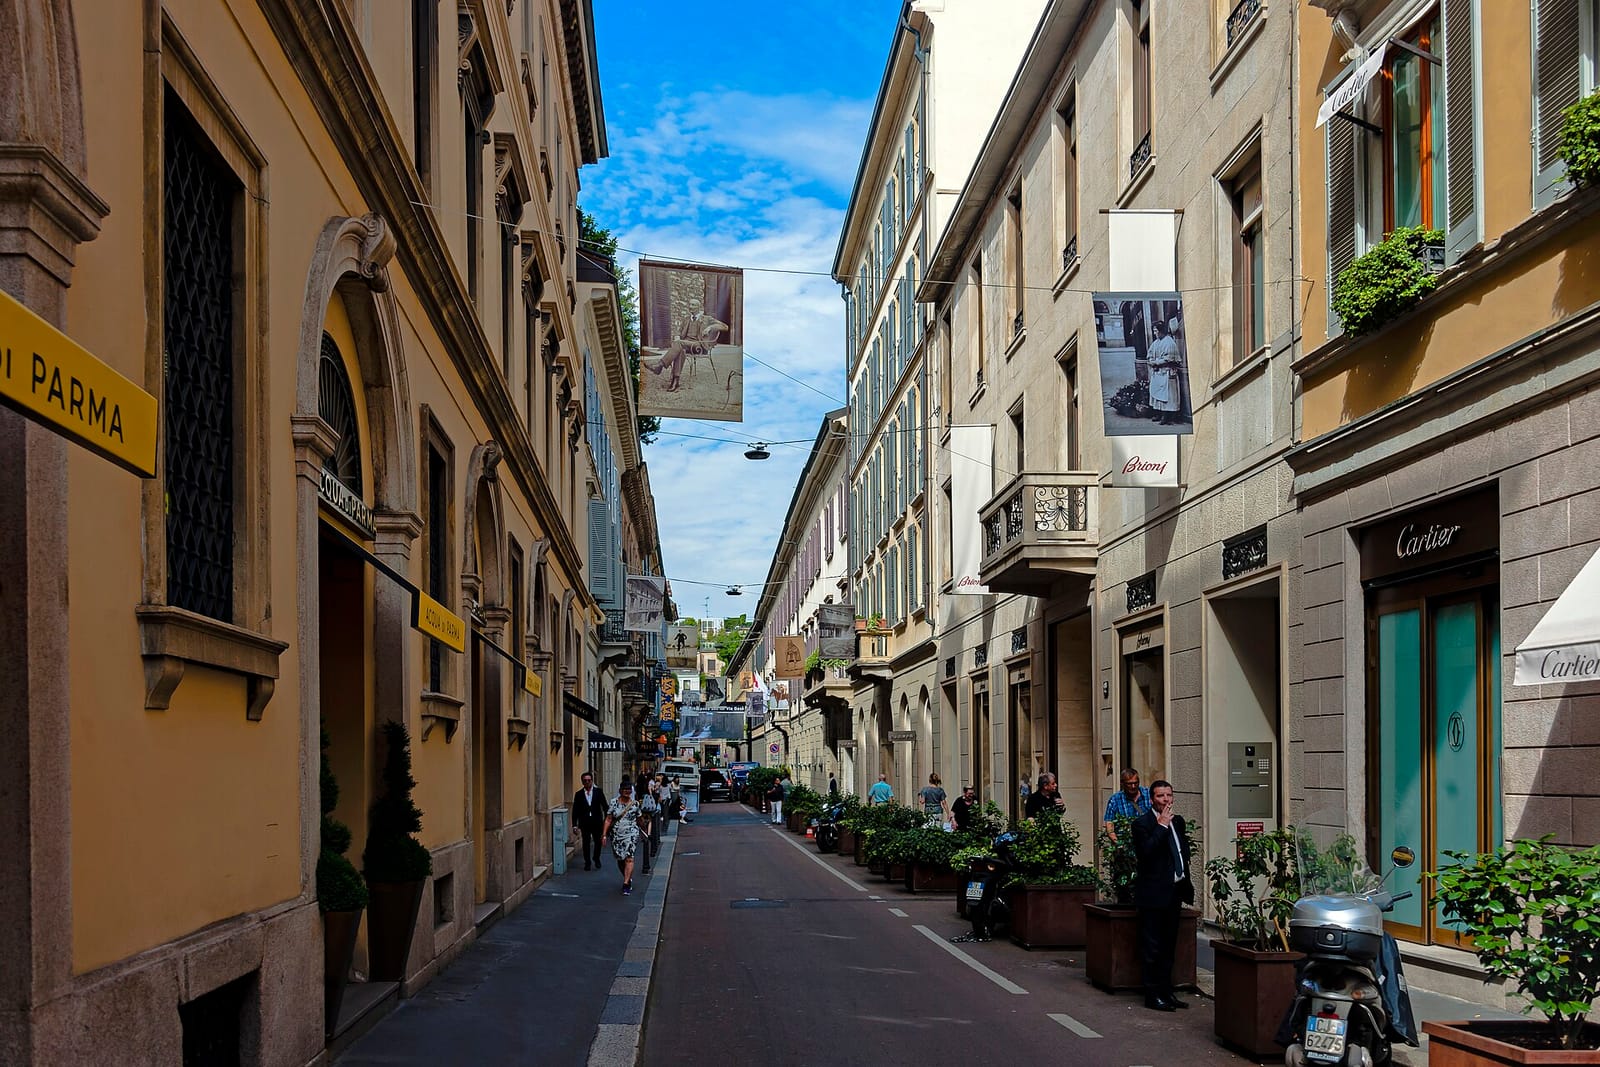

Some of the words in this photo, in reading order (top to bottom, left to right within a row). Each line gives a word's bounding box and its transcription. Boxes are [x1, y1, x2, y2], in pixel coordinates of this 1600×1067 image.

[1332, 69, 1369, 112] Cartier
[0, 347, 12, 383] I
[31, 352, 124, 444] PARMA
[1121, 455, 1169, 475] Brioni
[1396, 523, 1461, 560] Cartier
[1540, 649, 1600, 679] Cartier
